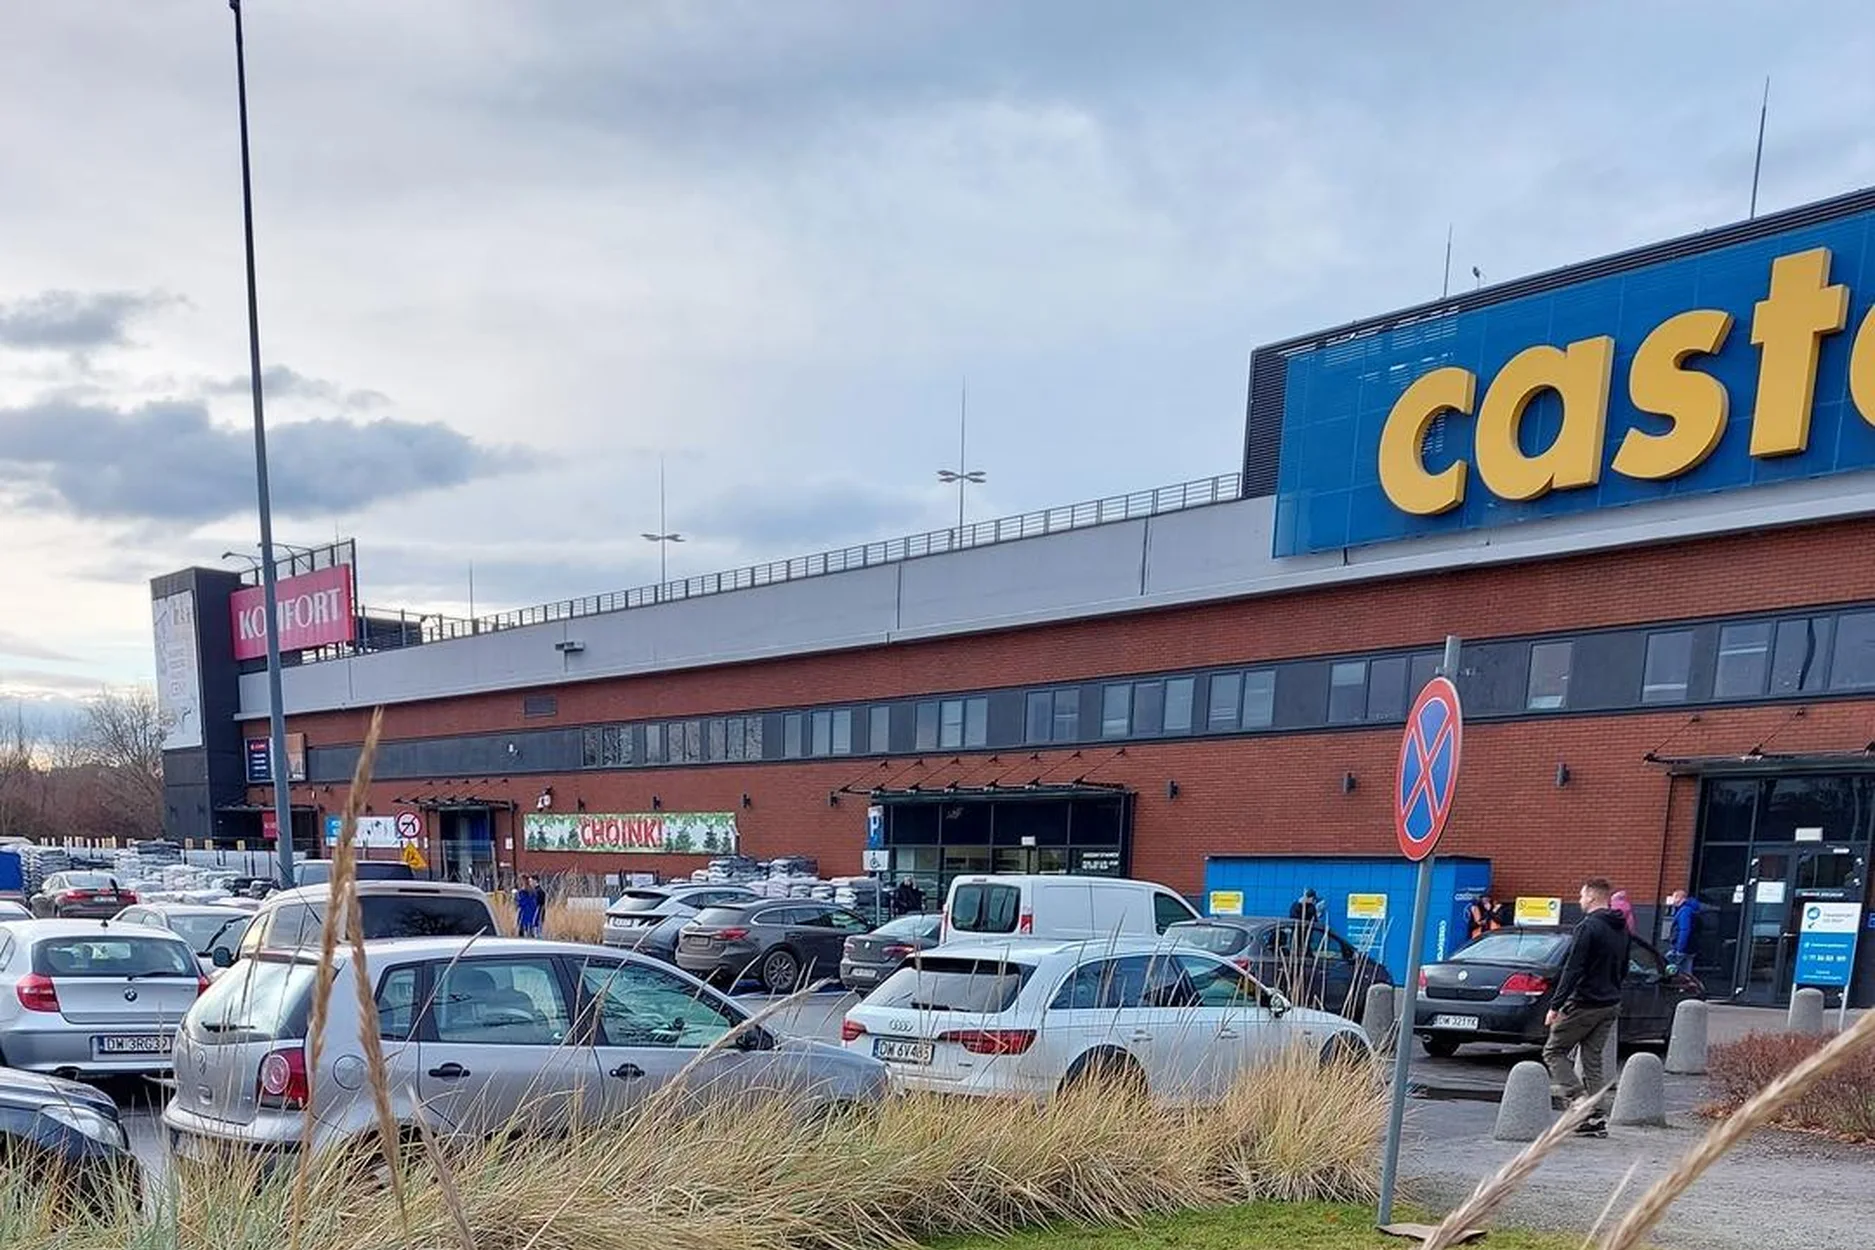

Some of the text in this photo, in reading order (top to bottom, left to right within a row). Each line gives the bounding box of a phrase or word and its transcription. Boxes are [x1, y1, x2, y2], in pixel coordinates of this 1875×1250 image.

[1377, 246, 1875, 515] cast
[870, 814, 880, 837] P
[106, 1036, 124, 1051] DW
[879, 1041, 895, 1056] DW
